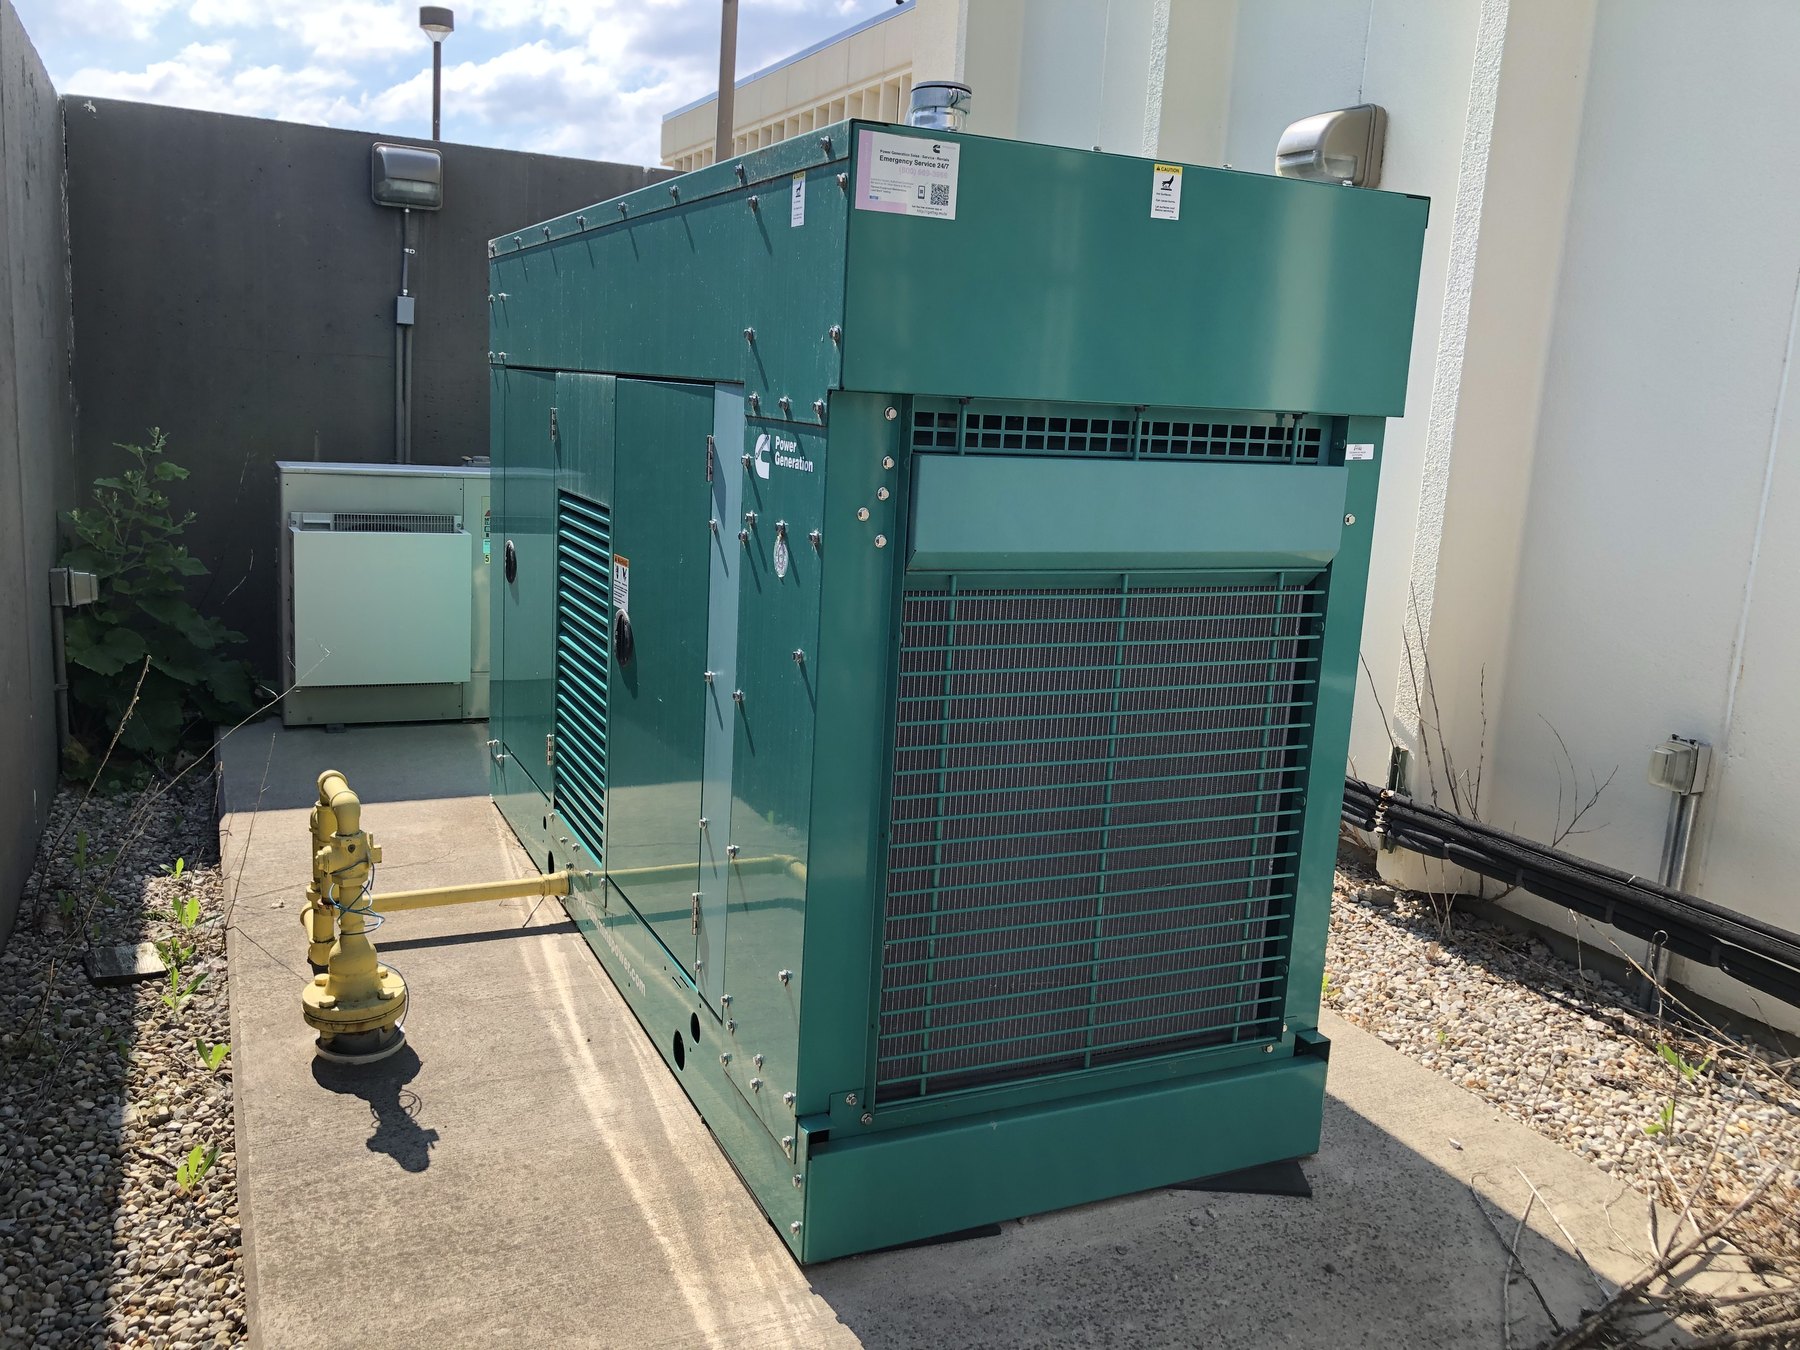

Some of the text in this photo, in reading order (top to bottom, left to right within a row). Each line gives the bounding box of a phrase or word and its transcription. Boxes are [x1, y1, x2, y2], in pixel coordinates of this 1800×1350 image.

[880, 155, 913, 166] Emergency
[914, 160, 936, 168] Service
[775, 436, 797, 452] Power
[774, 451, 814, 472] Generation
